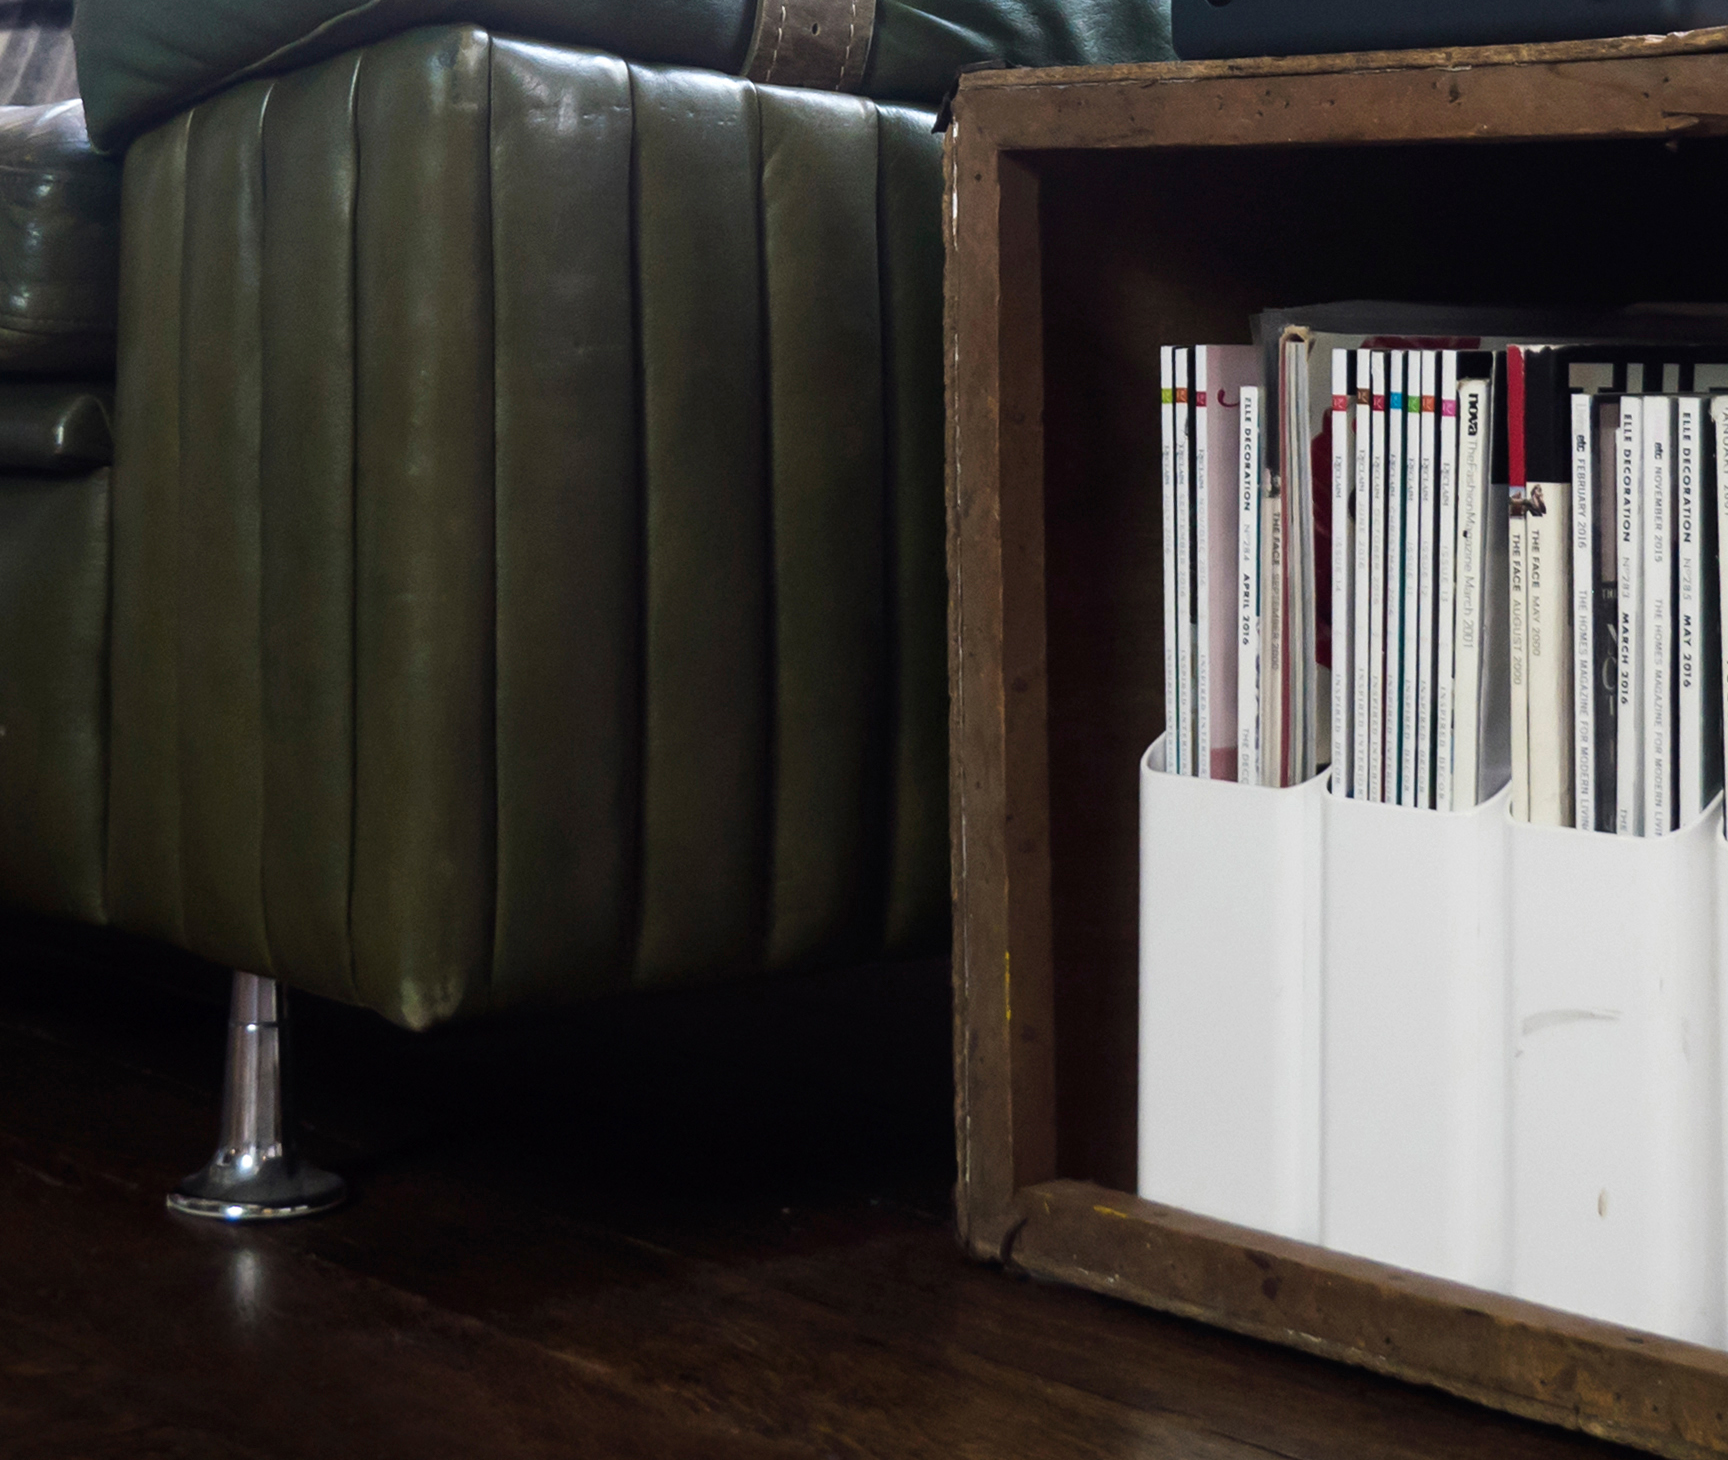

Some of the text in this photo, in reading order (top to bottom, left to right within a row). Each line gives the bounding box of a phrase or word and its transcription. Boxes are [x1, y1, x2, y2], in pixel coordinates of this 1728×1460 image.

[1244, 397, 1252, 422] ELLE
[1467, 393, 1480, 436] nova
[1683, 412, 1691, 441] ELLE
[1576, 434, 1586, 452] etc
[1623, 414, 1632, 442] ELLE
[1654, 442, 1663, 460] etc
[1577, 458, 1586, 517] FEBRUARY
[1623, 449, 1632, 542] DECORATION
[1654, 466, 1663, 530] NOVEMBER
[1682, 448, 1691, 543] DECORATION
[1272, 512, 1280, 533] THE
[1577, 521, 1586, 549] 2016
[1272, 537, 1280, 566] FACE
[1654, 534, 1663, 563] 2015
[1242, 573, 1250, 608] APRIL
[1463, 576, 1475, 616] March
[1531, 530, 1540, 657] THE FACE MAY 2000
[1578, 590, 1588, 612] THE
[1512, 533, 1522, 686] THE FACE AUGUST 2000
[1654, 599, 1663, 620] THE
[1242, 615, 1250, 646] 2016
[1462, 619, 1474, 649] 2001
[1578, 615, 1588, 655] HOMES
[1620, 612, 1630, 665] MARCH
[1654, 624, 1663, 665] HOMES
[1682, 614, 1692, 647] MAY
[1682, 652, 1692, 688] 2016
[1578, 659, 1588, 717] MAGAZINE
[1620, 671, 1630, 705] 2016
[1654, 669, 1663, 728] MAGAZINE
[1241, 729, 1249, 749] THE
[1579, 720, 1588, 742] FOR
[1654, 732, 1663, 754] FOR
[1579, 746, 1588, 794] MODERN
[1654, 758, 1663, 807] MODERN
